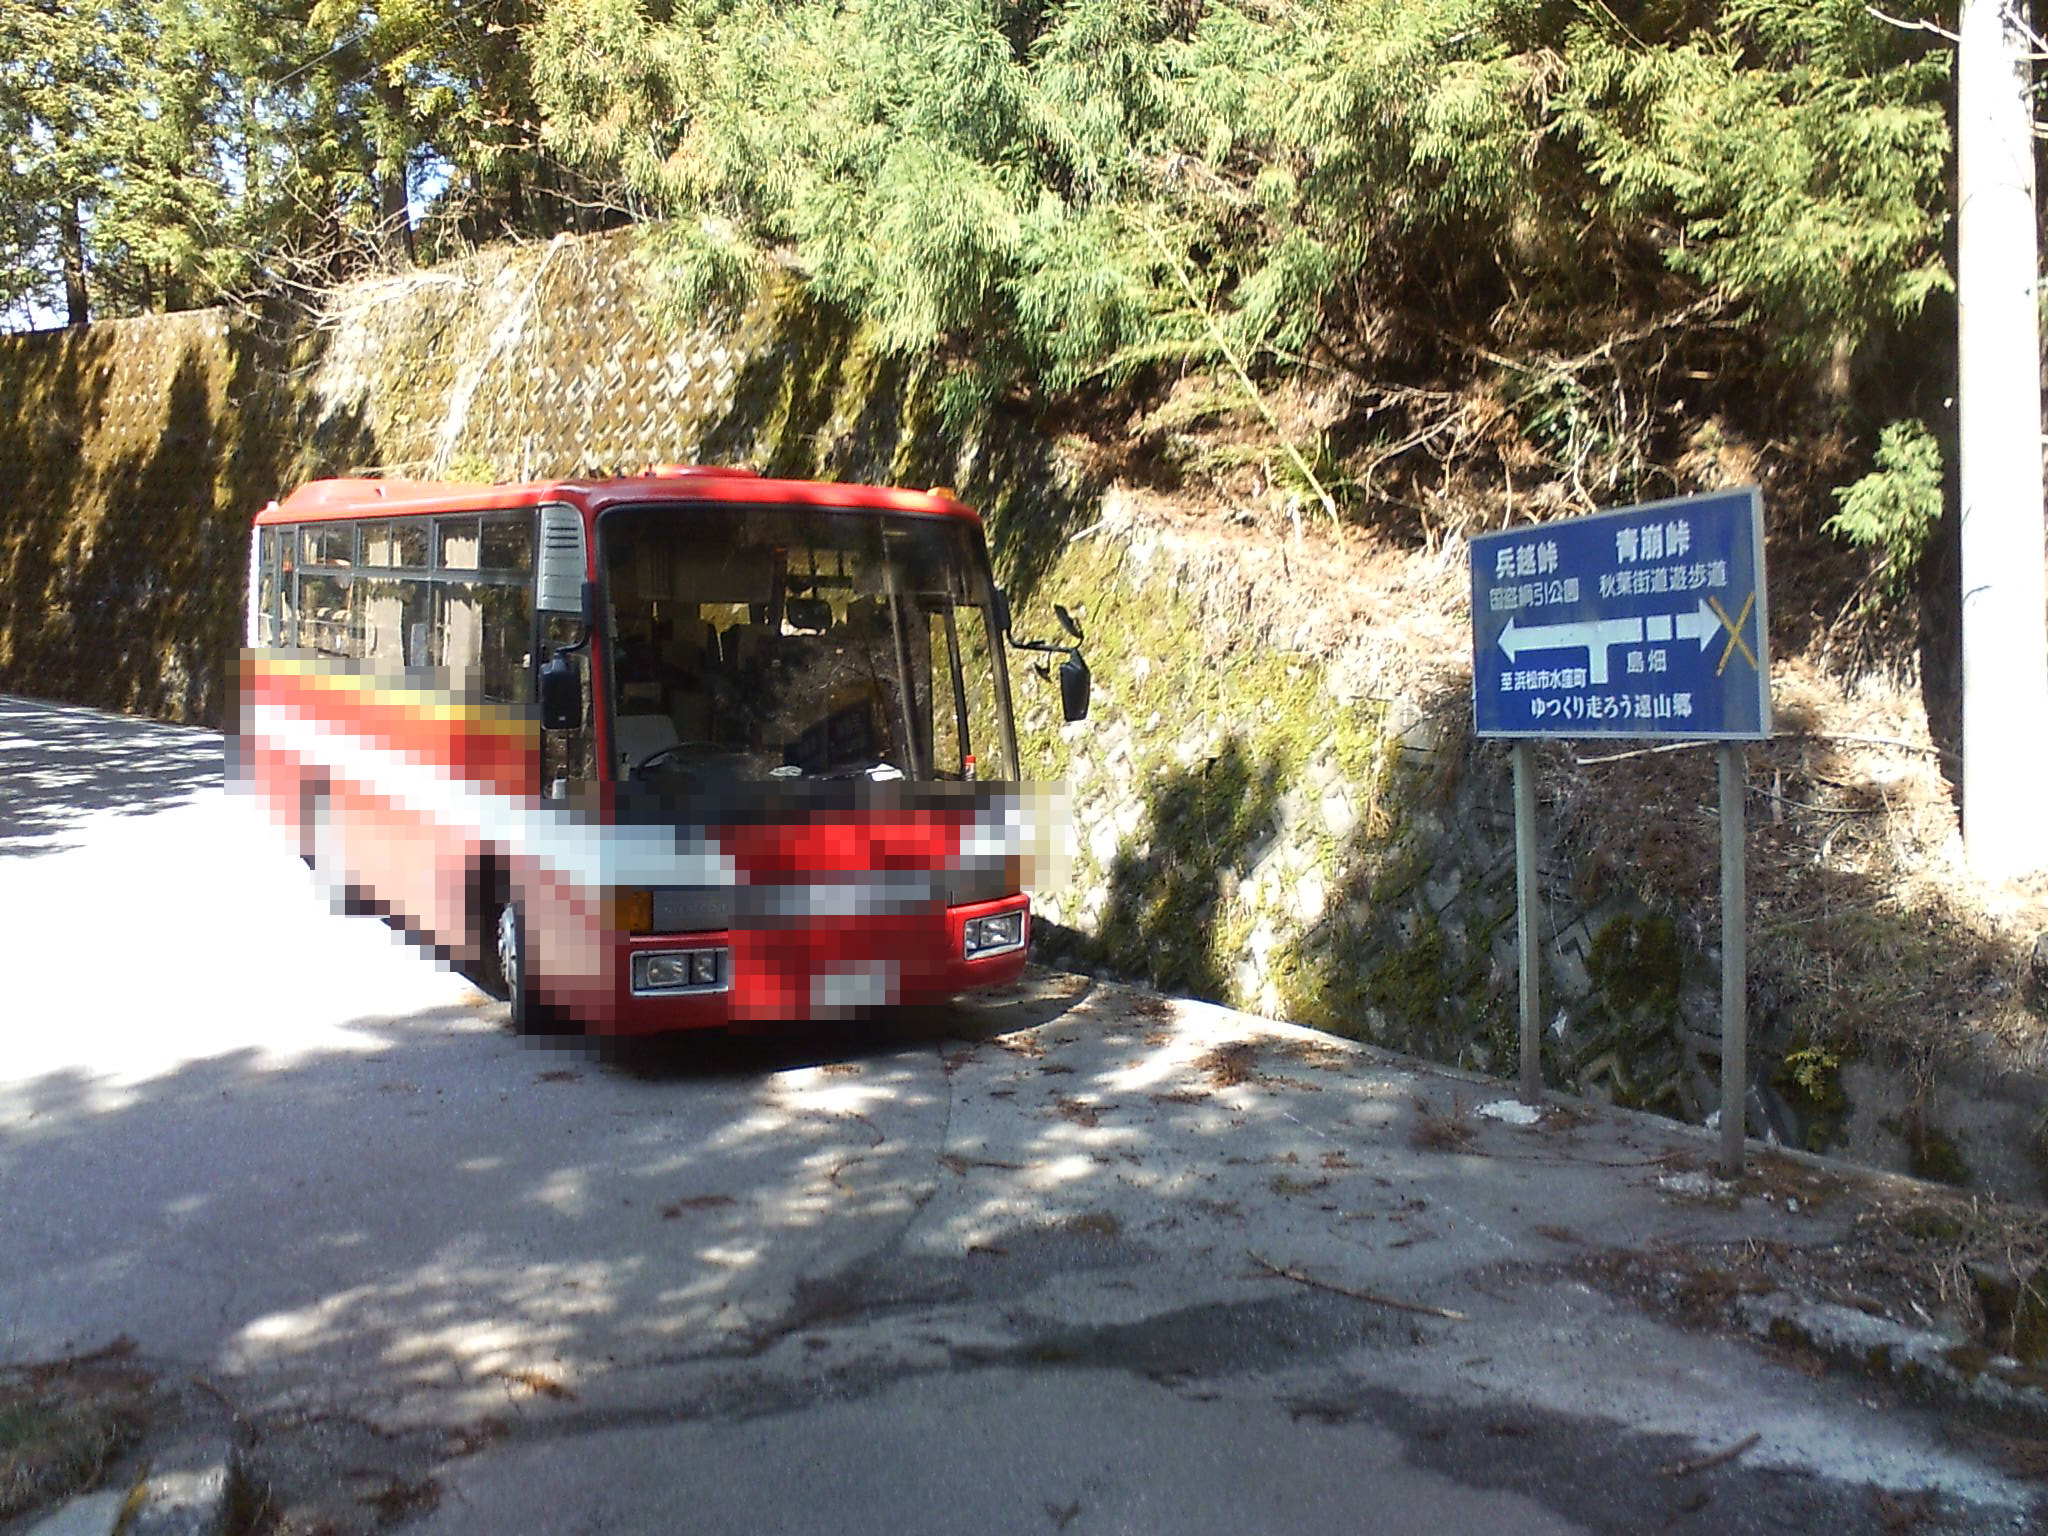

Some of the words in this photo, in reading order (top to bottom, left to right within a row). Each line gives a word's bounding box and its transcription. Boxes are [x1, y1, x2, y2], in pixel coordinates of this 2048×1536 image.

[1496, 540, 1558, 579] 兵越峠
[1616, 520, 1690, 563] 青崩峠
